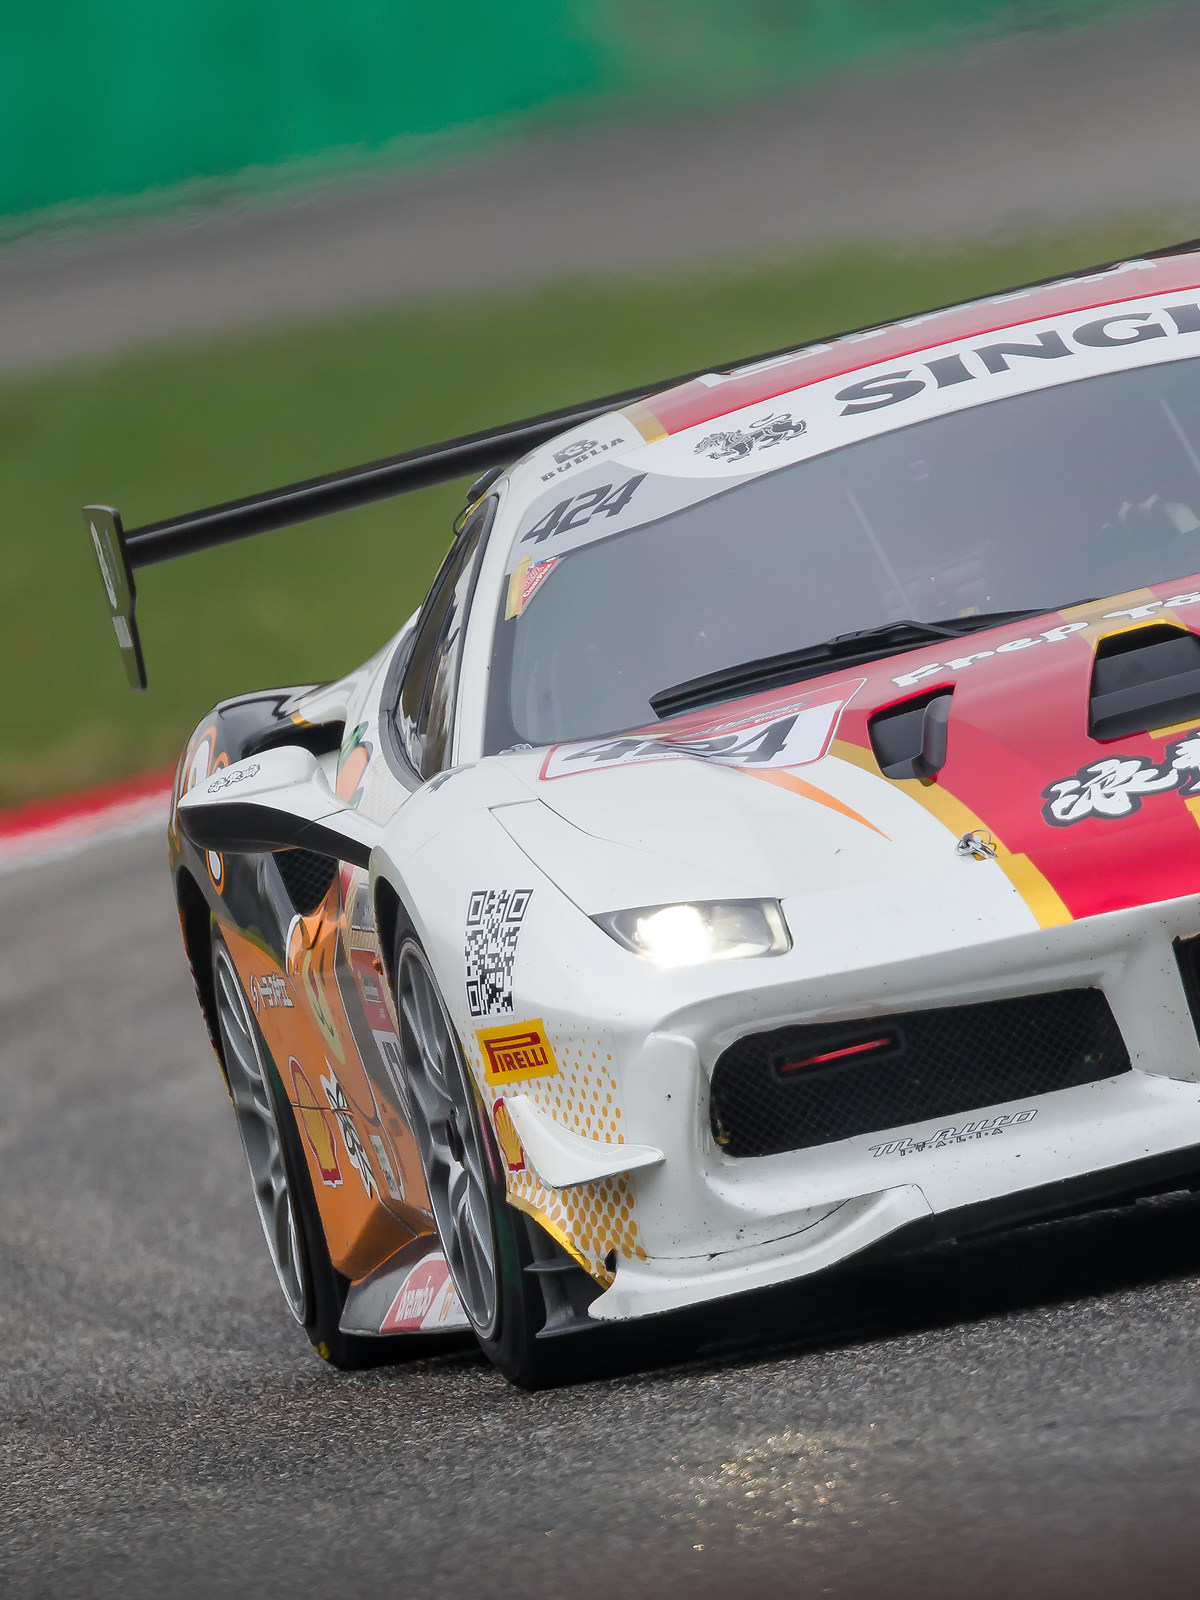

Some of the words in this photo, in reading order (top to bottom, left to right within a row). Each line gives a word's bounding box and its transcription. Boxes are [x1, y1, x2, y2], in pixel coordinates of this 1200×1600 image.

[541, 437, 625, 482] BUBLIA
[519, 472, 650, 545] 424
[483, 1031, 550, 1074] PIRELLI
[394, 1275, 435, 1323] brembo
